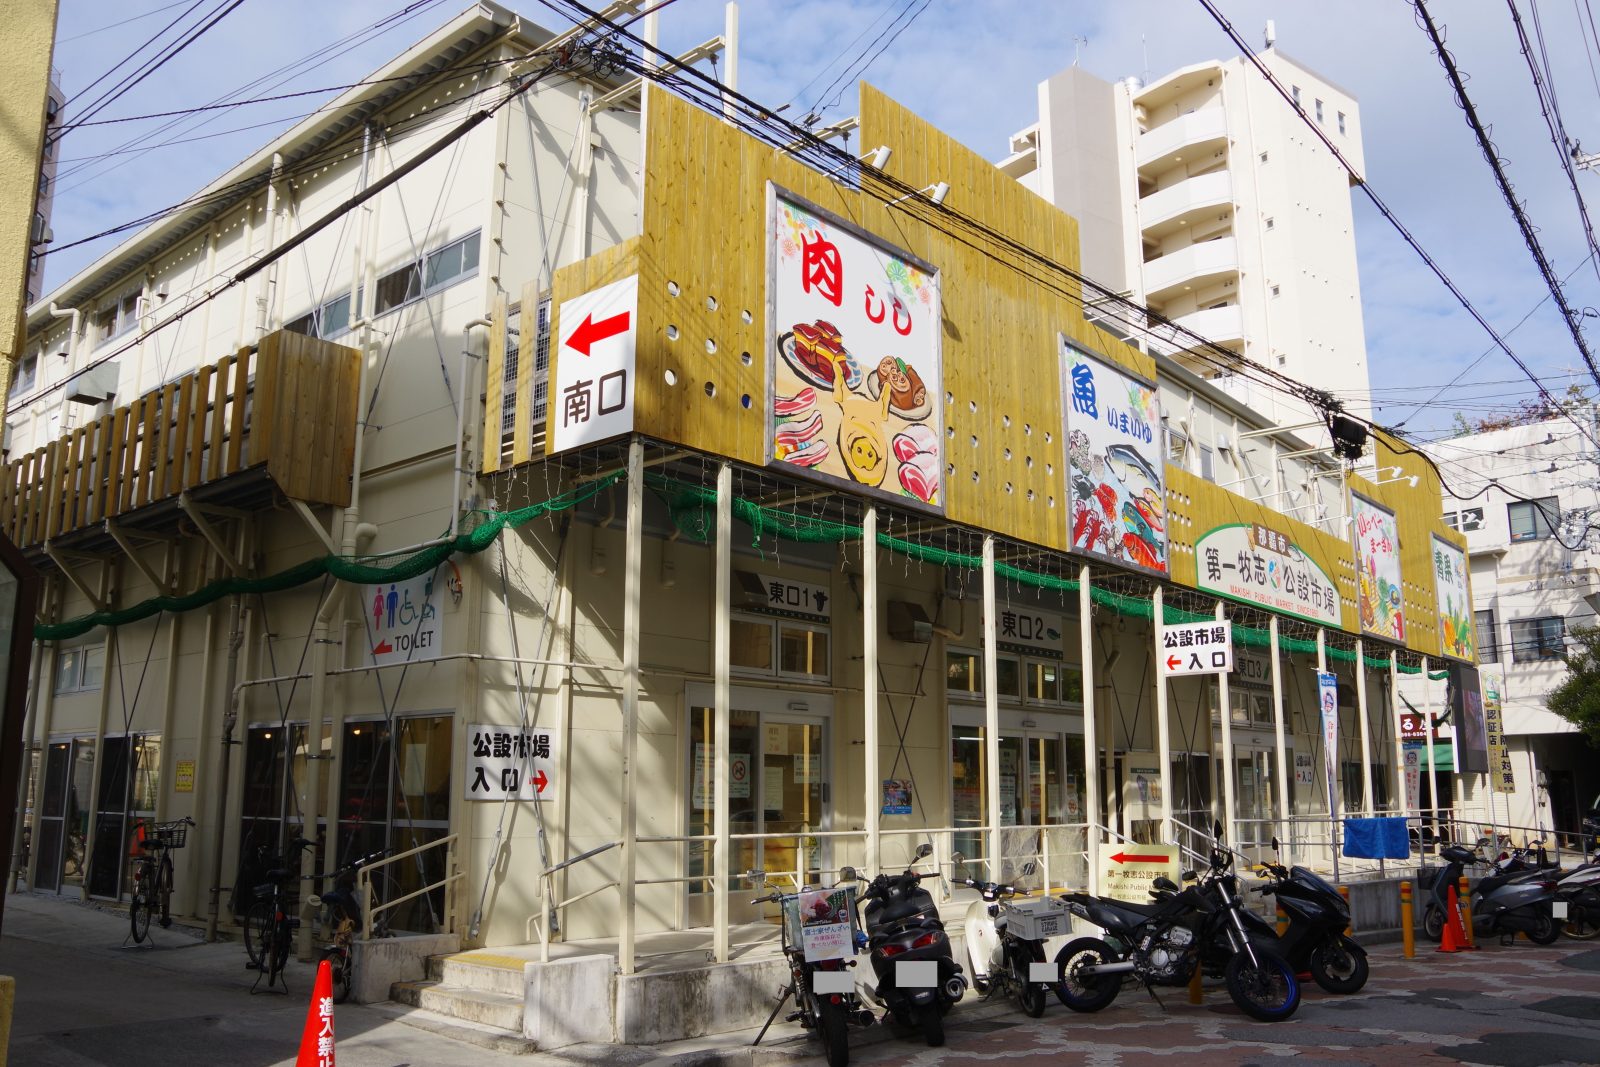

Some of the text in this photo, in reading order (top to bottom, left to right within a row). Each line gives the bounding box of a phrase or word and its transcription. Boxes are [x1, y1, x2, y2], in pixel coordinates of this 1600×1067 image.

[800, 230, 843, 307] 肉
[563, 368, 627, 428] 南口
[1071, 361, 1098, 420] 魚
[1107, 406, 1153, 444] いまいゆ
[1258, 526, 1286, 553] 那覇市
[769, 581, 808, 607] 東口1
[1206, 547, 1335, 617] 第一牧志 公設市場
[1254, 591, 1272, 605] PUBLIC
[1275, 598, 1294, 611] MARKET
[1002, 610, 1044, 641] 東口2
[1164, 627, 1226, 648] 公設市場
[395, 630, 434, 652] TOILET
[1188, 651, 1226, 670] 入口
[1238, 658, 1262, 678] 東口3
[473, 732, 550, 759] 公設市場
[471, 766, 519, 792] 入口
